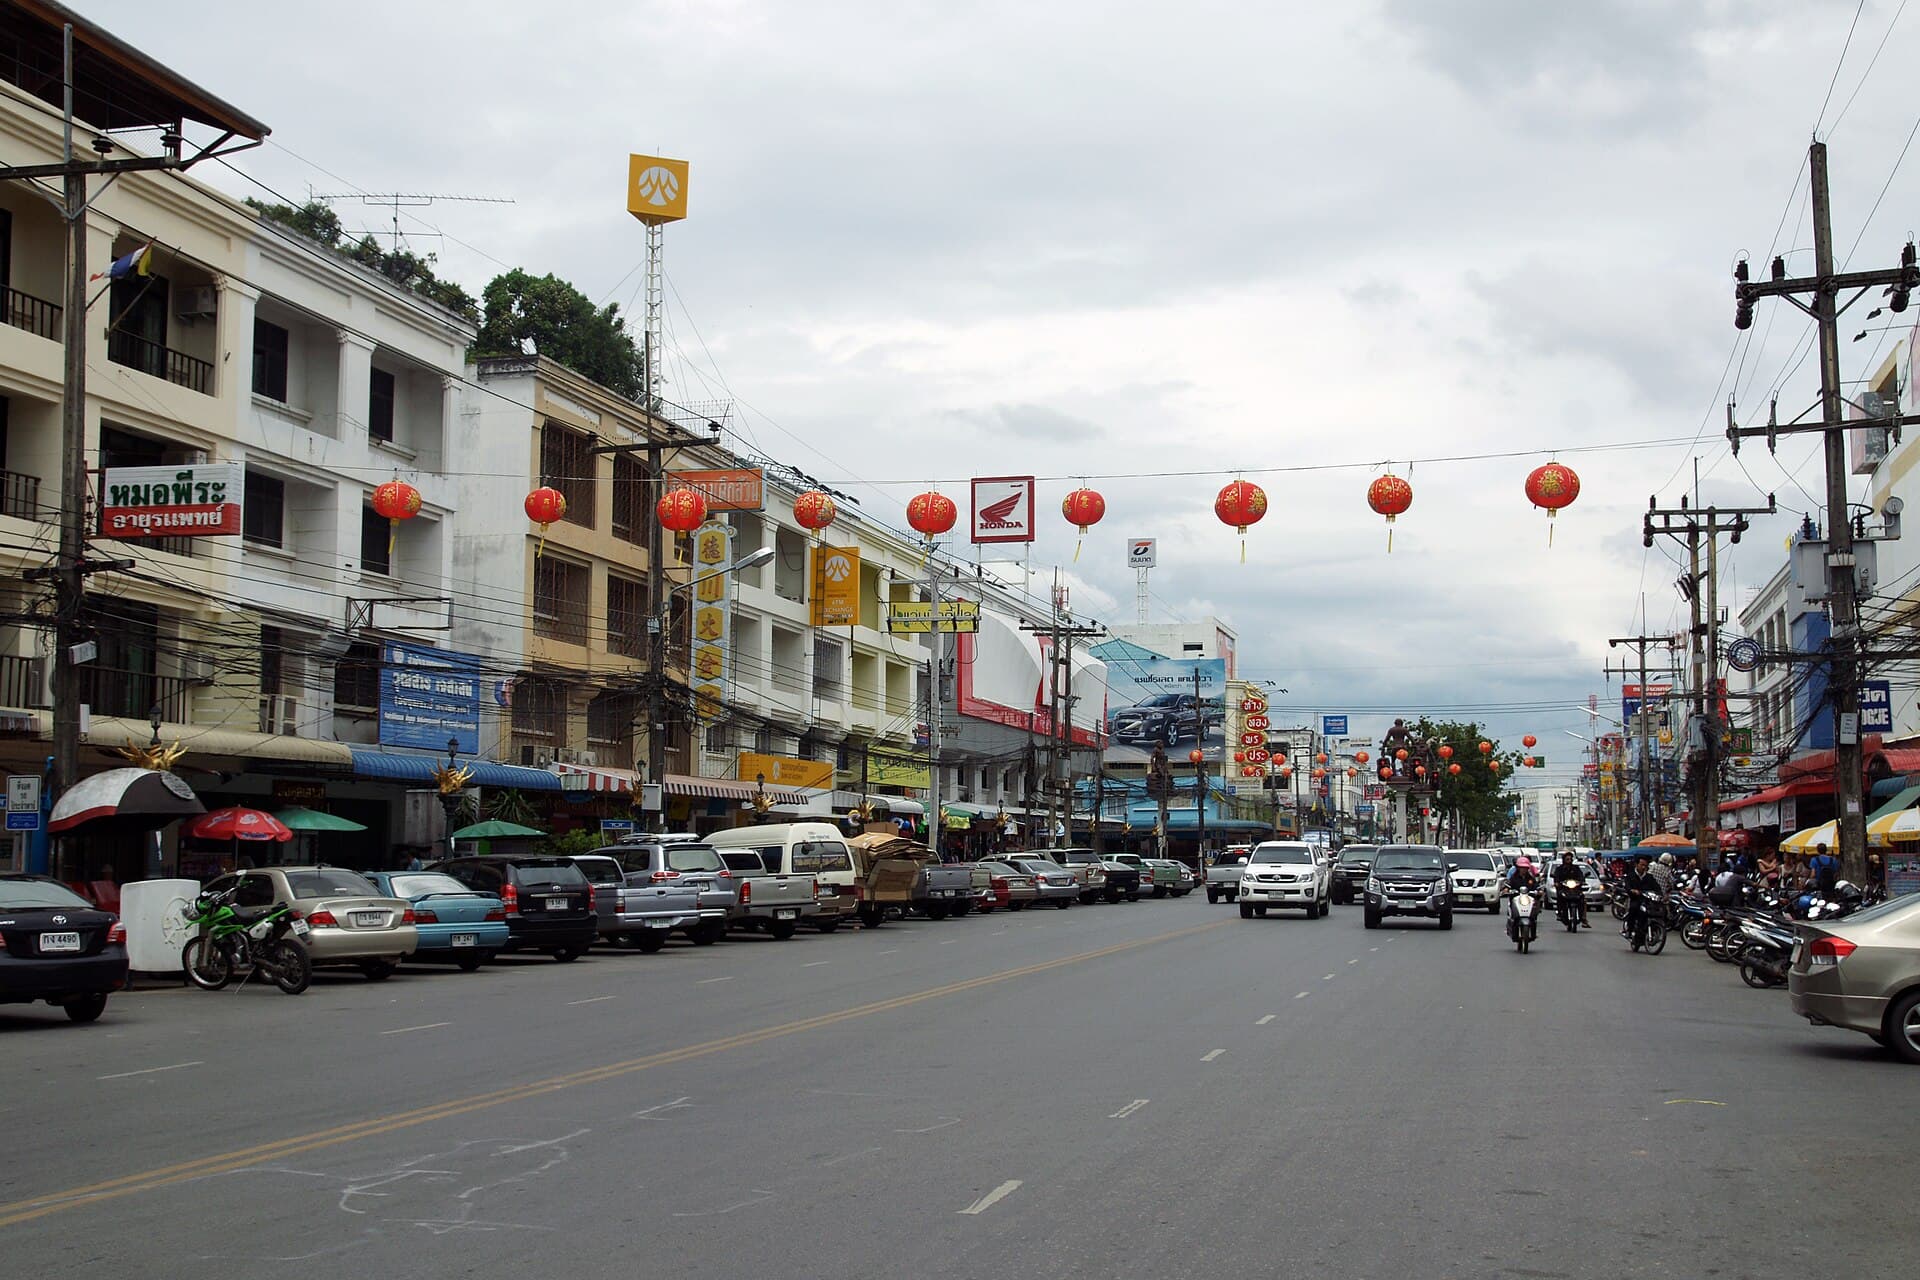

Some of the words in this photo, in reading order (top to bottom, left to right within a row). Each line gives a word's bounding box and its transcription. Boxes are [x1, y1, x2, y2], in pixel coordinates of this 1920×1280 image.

[110, 470, 226, 506] หมอพีระ
[113, 504, 225, 534] อายุรแพทย์
[980, 521, 1024, 530] HONDA
[57, 935, 77, 943] 4490
